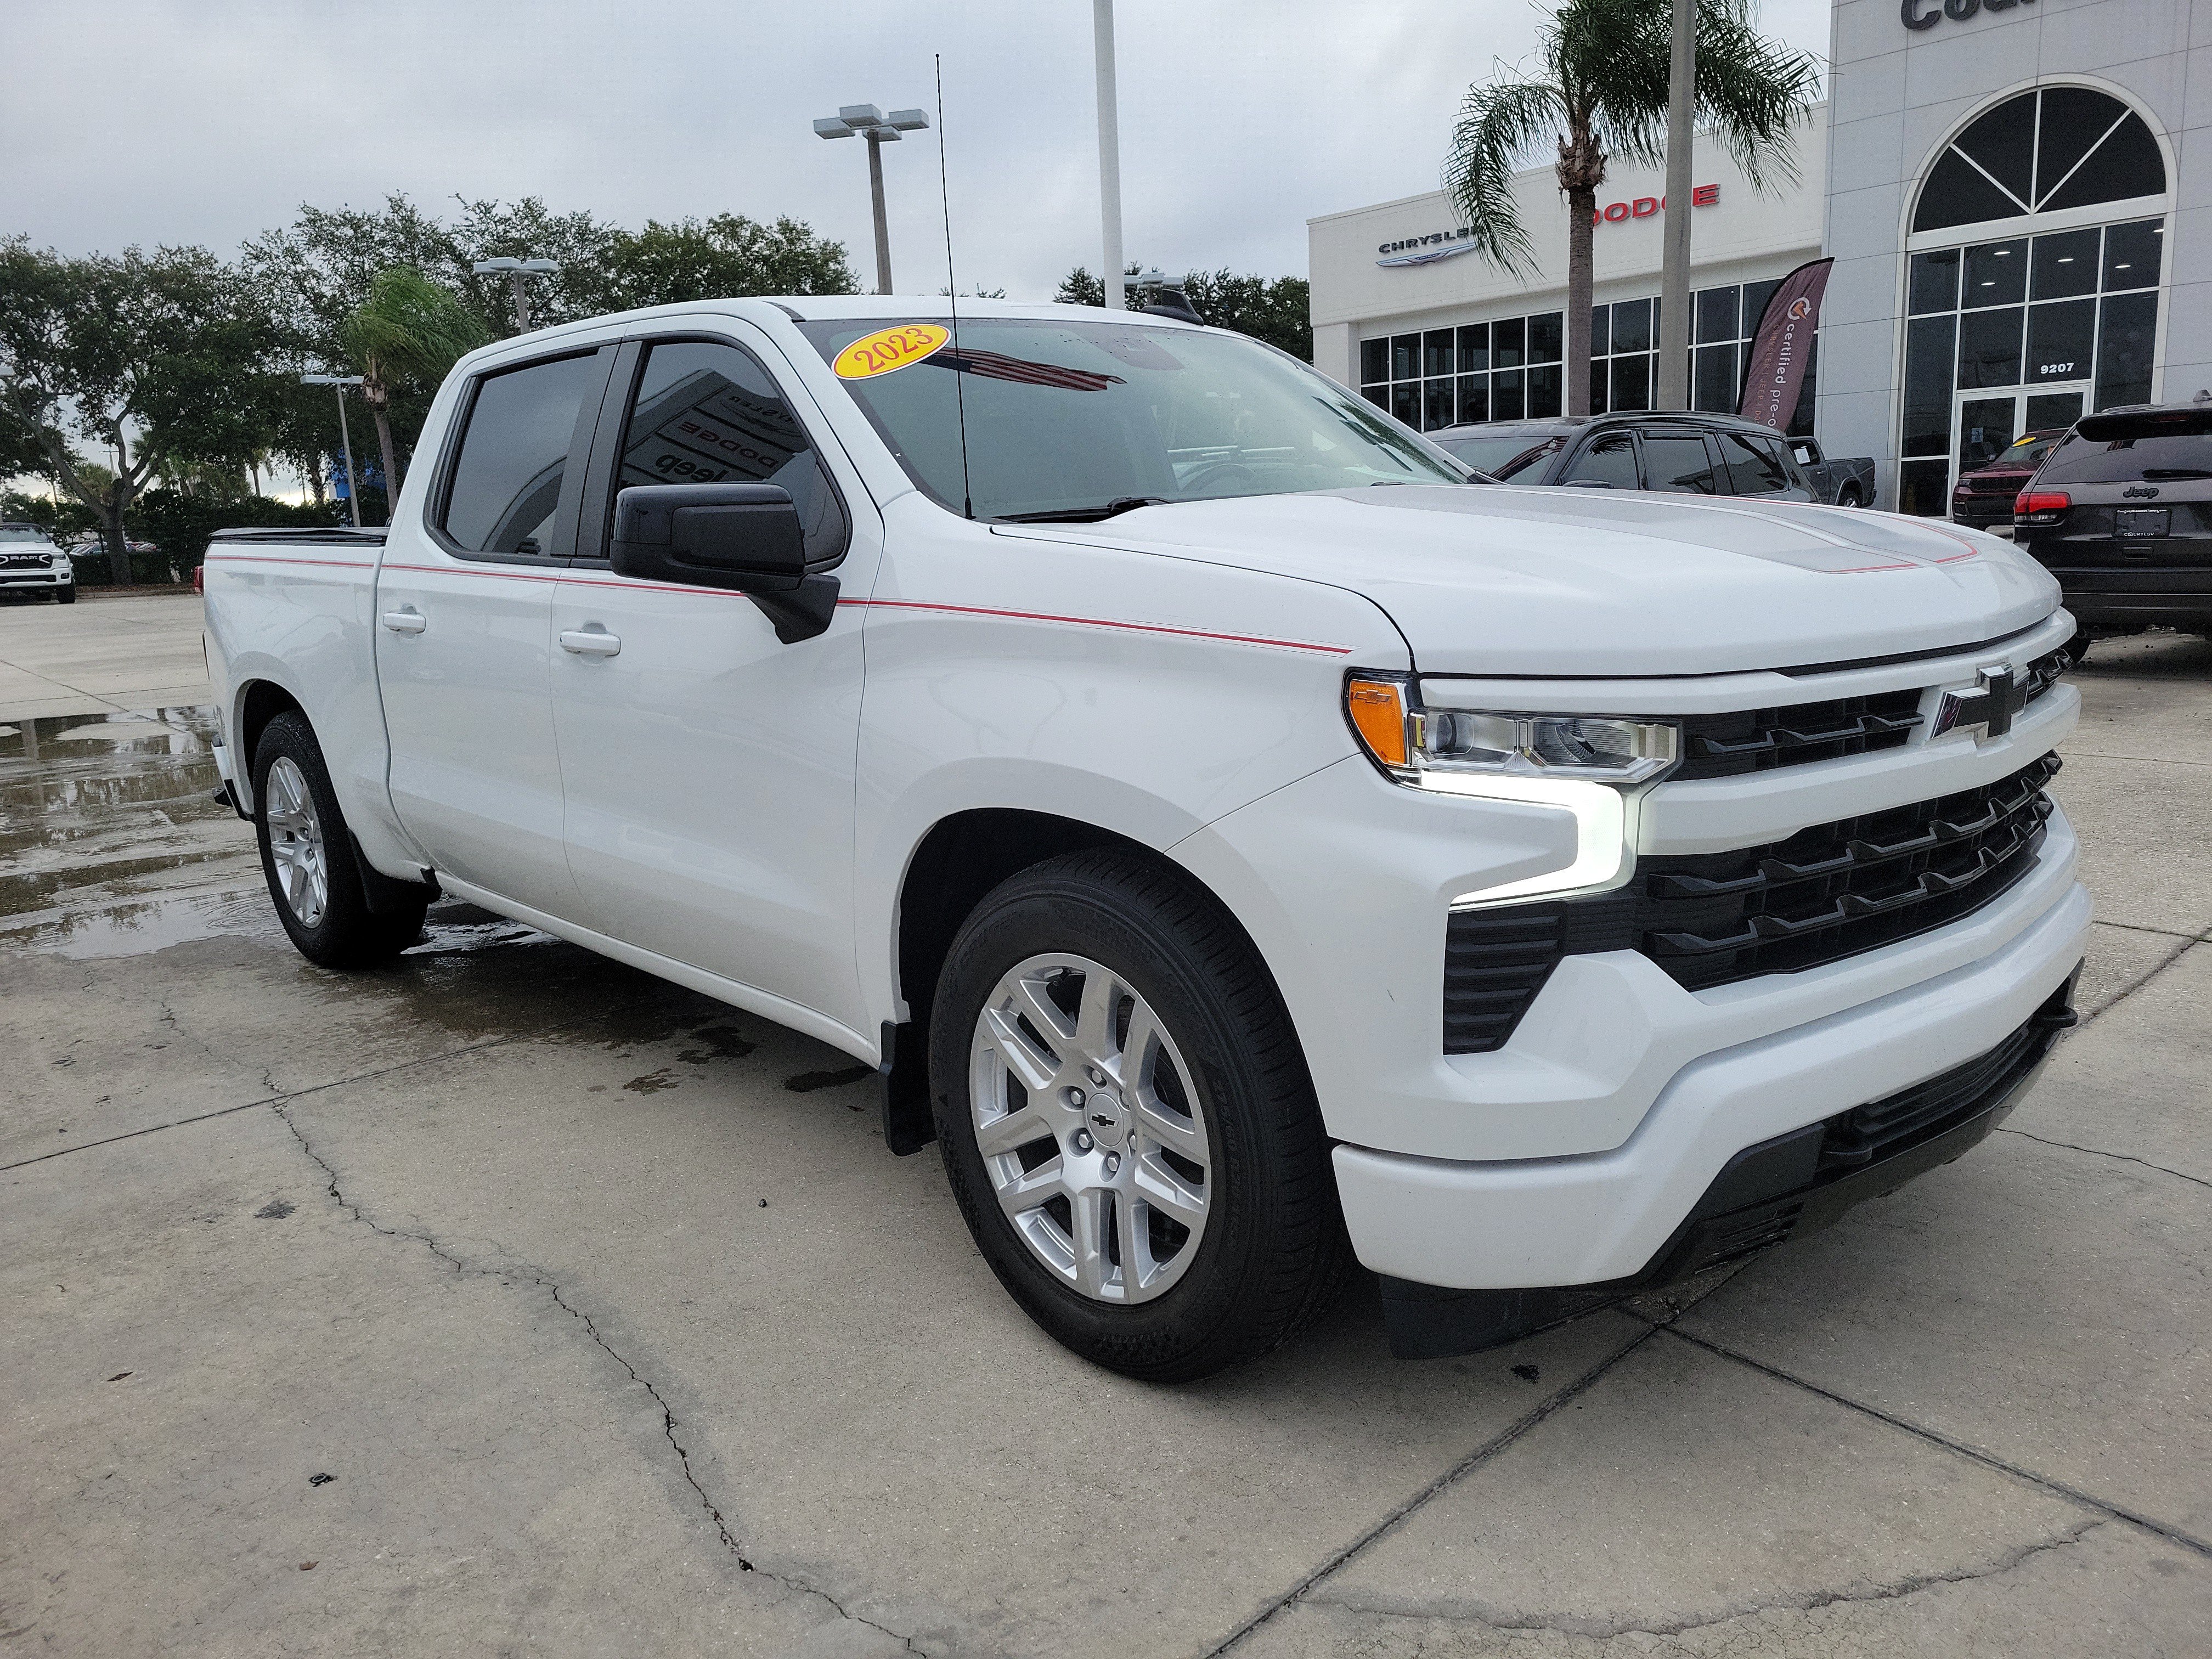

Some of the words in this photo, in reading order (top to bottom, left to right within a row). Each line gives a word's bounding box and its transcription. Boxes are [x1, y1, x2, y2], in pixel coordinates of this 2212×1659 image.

[1593, 184, 1720, 225] ODE
[854, 328, 933, 372] 2023
[1775, 324, 1795, 383] certified
[2040, 363, 2074, 374] 9207
[1758, 379, 1767, 400] JEEP
[2123, 486, 2159, 499] Jeep
